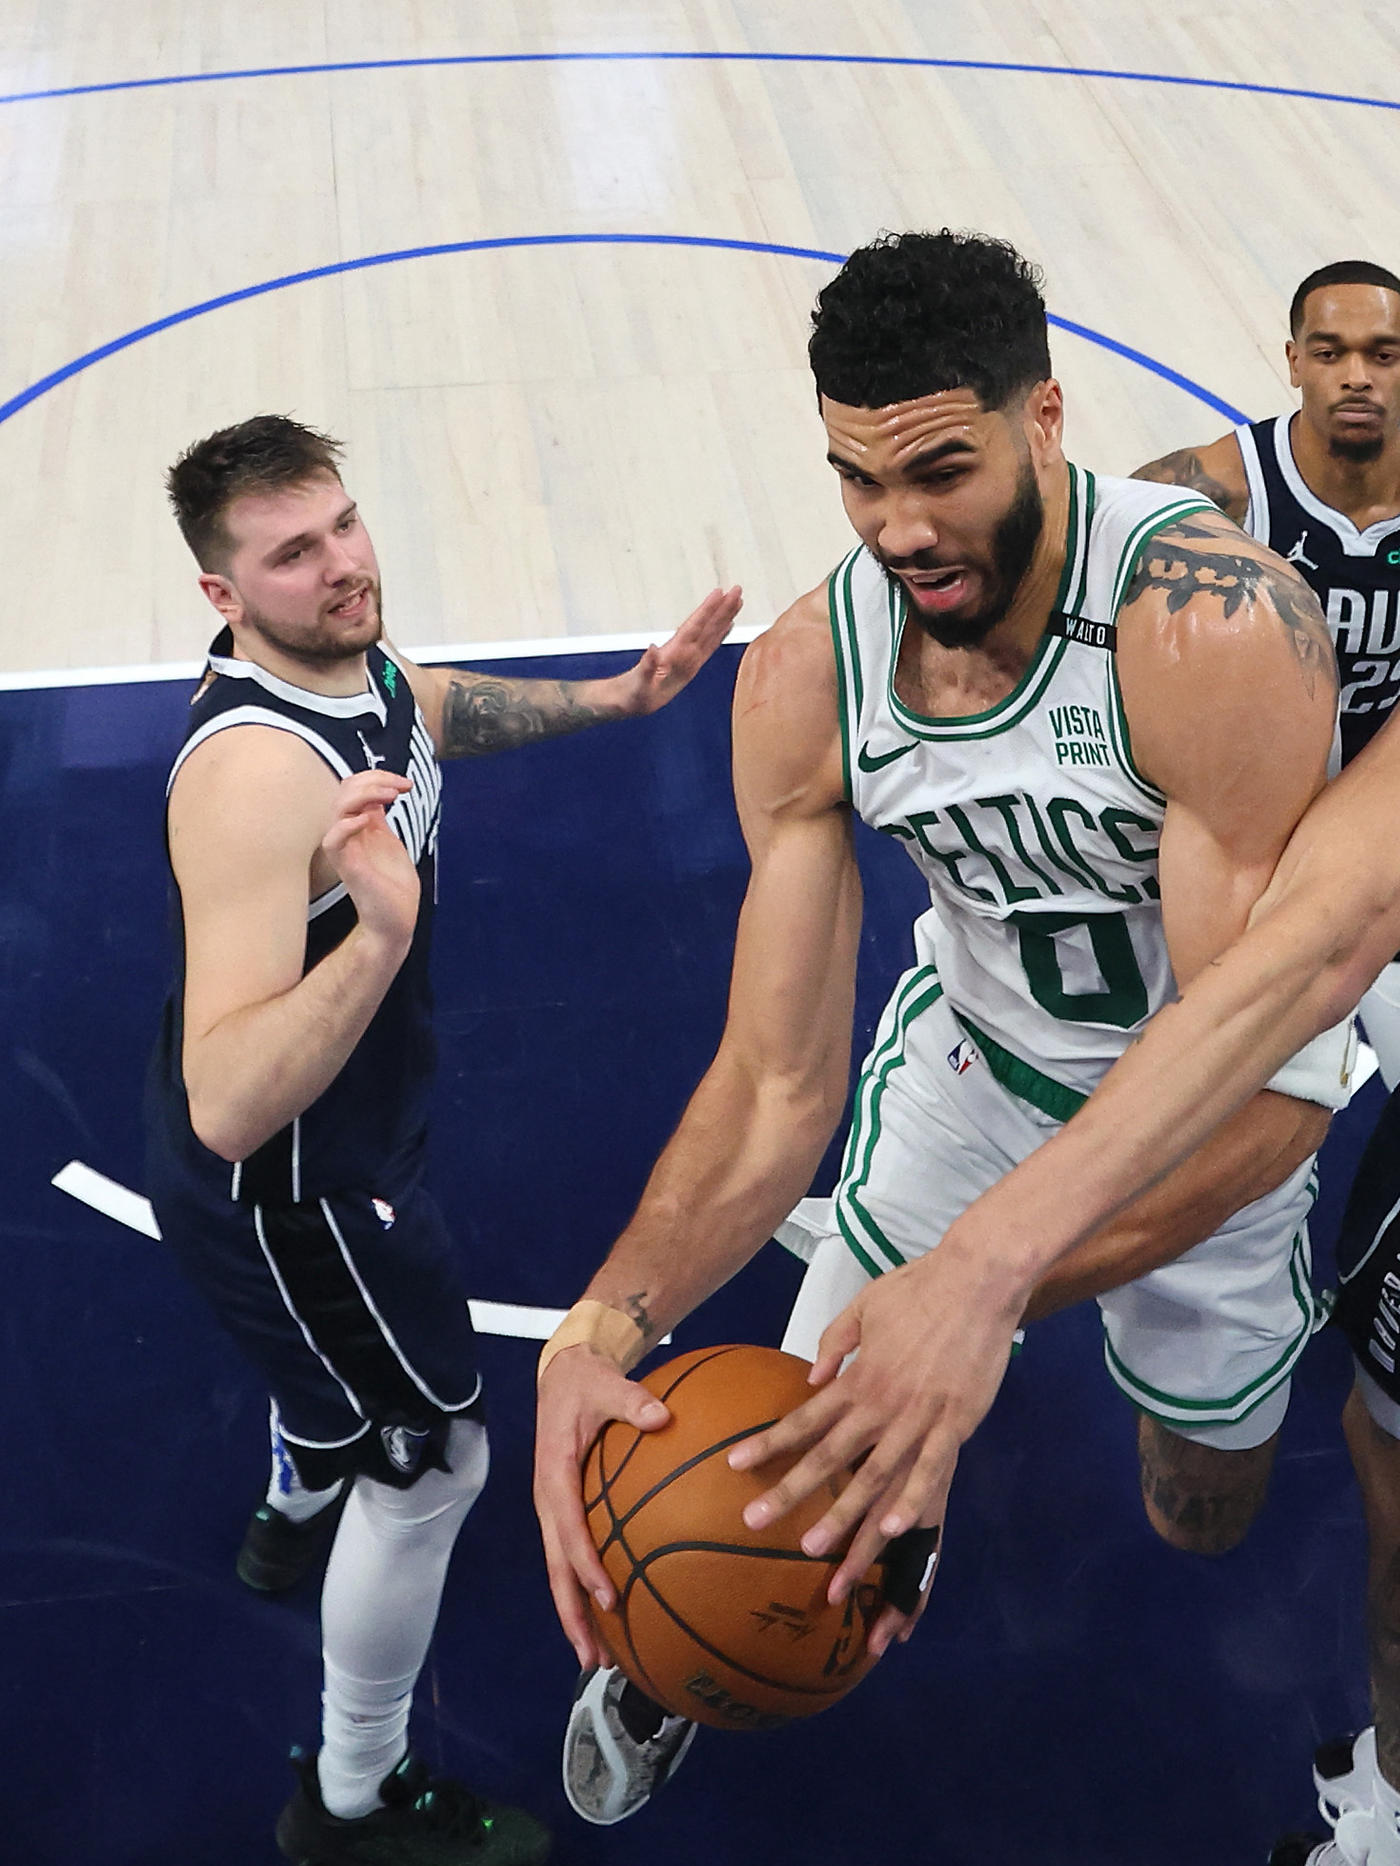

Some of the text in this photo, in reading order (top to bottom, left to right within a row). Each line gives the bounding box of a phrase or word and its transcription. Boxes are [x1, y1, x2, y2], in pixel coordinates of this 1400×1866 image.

[1048, 704, 1106, 742] VISTA
[1055, 741, 1111, 767] PRINT
[1002, 909, 1149, 1030] 0
